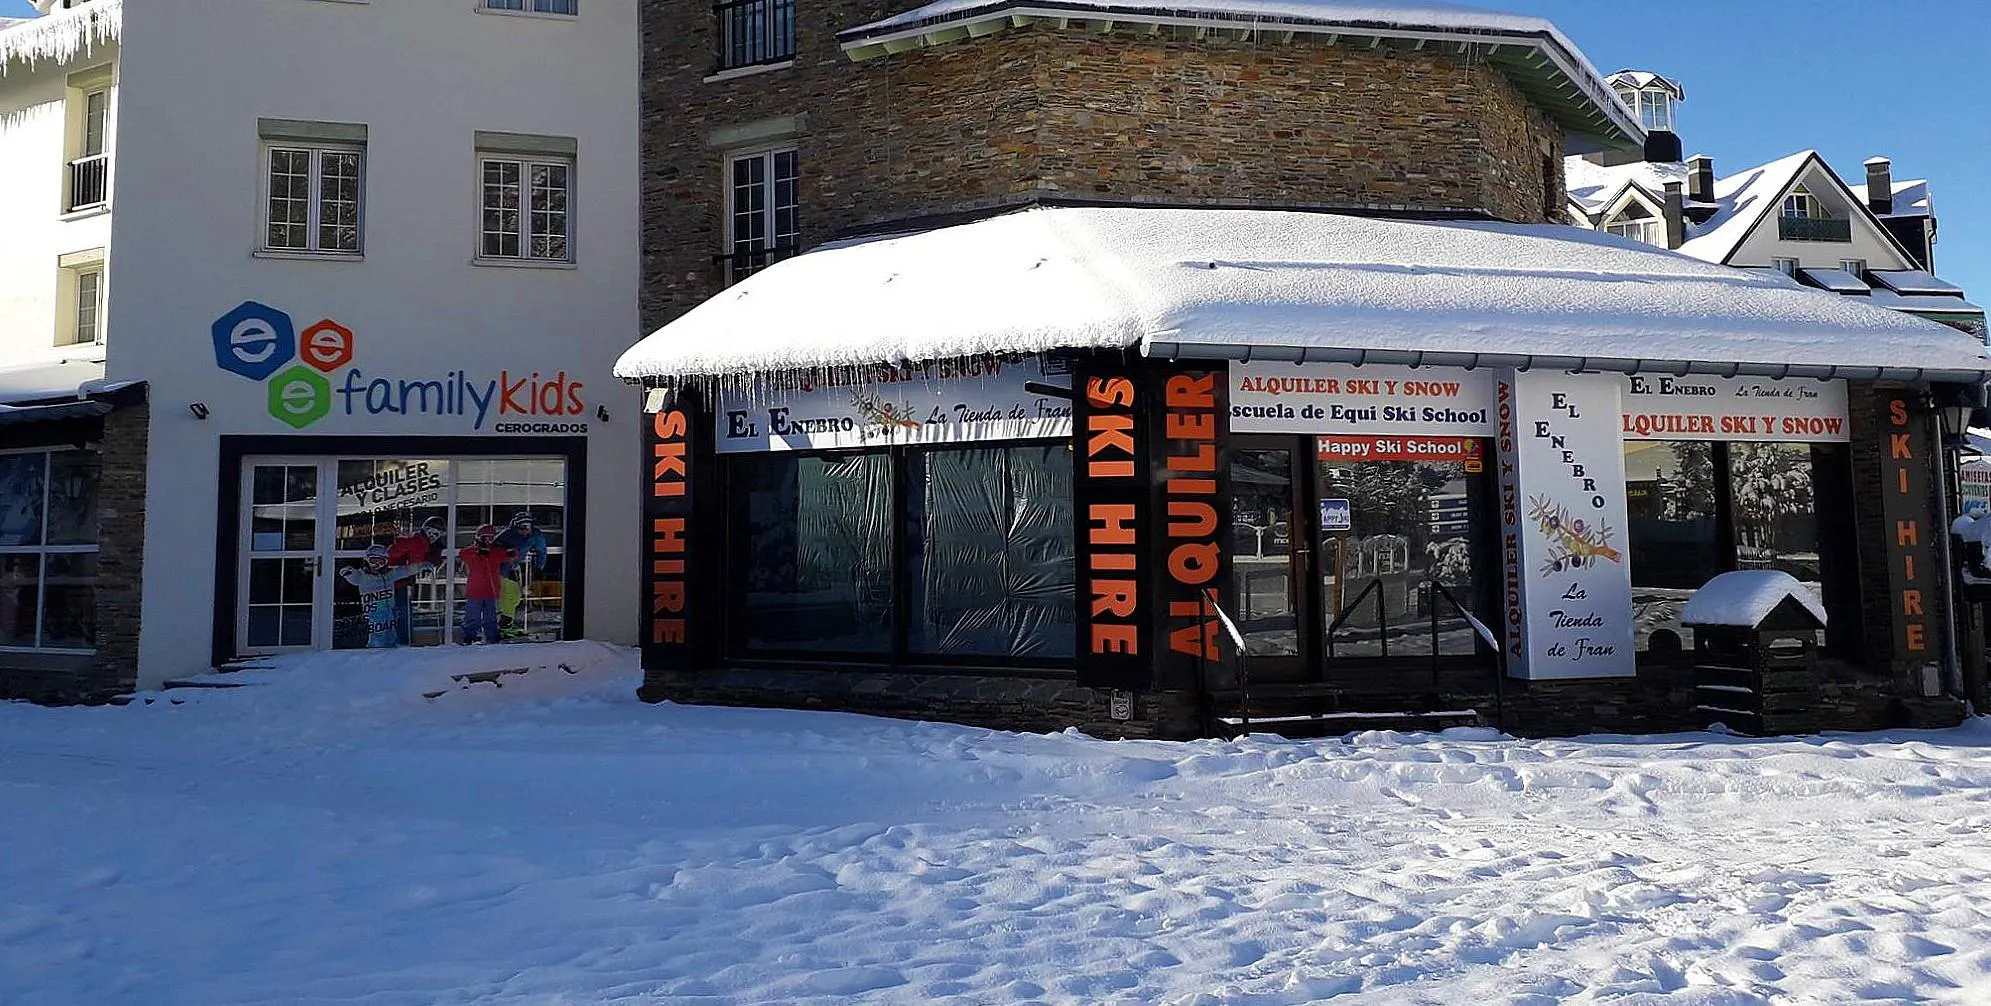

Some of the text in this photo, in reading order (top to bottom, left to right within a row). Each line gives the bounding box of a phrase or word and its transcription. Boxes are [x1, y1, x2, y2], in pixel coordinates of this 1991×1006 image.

[1239, 376, 1461, 398] ALQUILER SKI Y SNOW
[1659, 376, 1716, 397] ENEBRO
[1735, 385, 1749, 398] La
[1752, 385, 1781, 398] Tienda
[1783, 387, 1793, 398] de
[1796, 384, 1819, 402] Fran
[495, 422, 588, 434] CEROGRADOS
[767, 407, 854, 436] ENEBRO
[924, 404, 948, 426] La
[953, 400, 1003, 424] Tienda
[1008, 401, 1026, 421] de
[1031, 397, 1072, 427] Fran
[1229, 403, 1488, 424] scuela de Equi Ski School
[1622, 413, 1844, 437] LQUILER SKI Y SNOW
[1318, 438, 1462, 457] Happy Ski School
[1889, 398, 1912, 495] SKI
[340, 462, 430, 497] ALQUILER
[355, 474, 441, 507] Y CLASES
[653, 409, 687, 645] SKI HIRE
[1087, 375, 1139, 656] SKI HIRE
[1165, 373, 1222, 663] ALQUILER
[1496, 380, 1523, 659] ALQUILER SKI Y SNOW
[1561, 582, 1587, 601] La
[1896, 519, 1925, 652] HIRE
[1550, 610, 1604, 629] Tienda
[1547, 637, 1616, 662] de Fran
